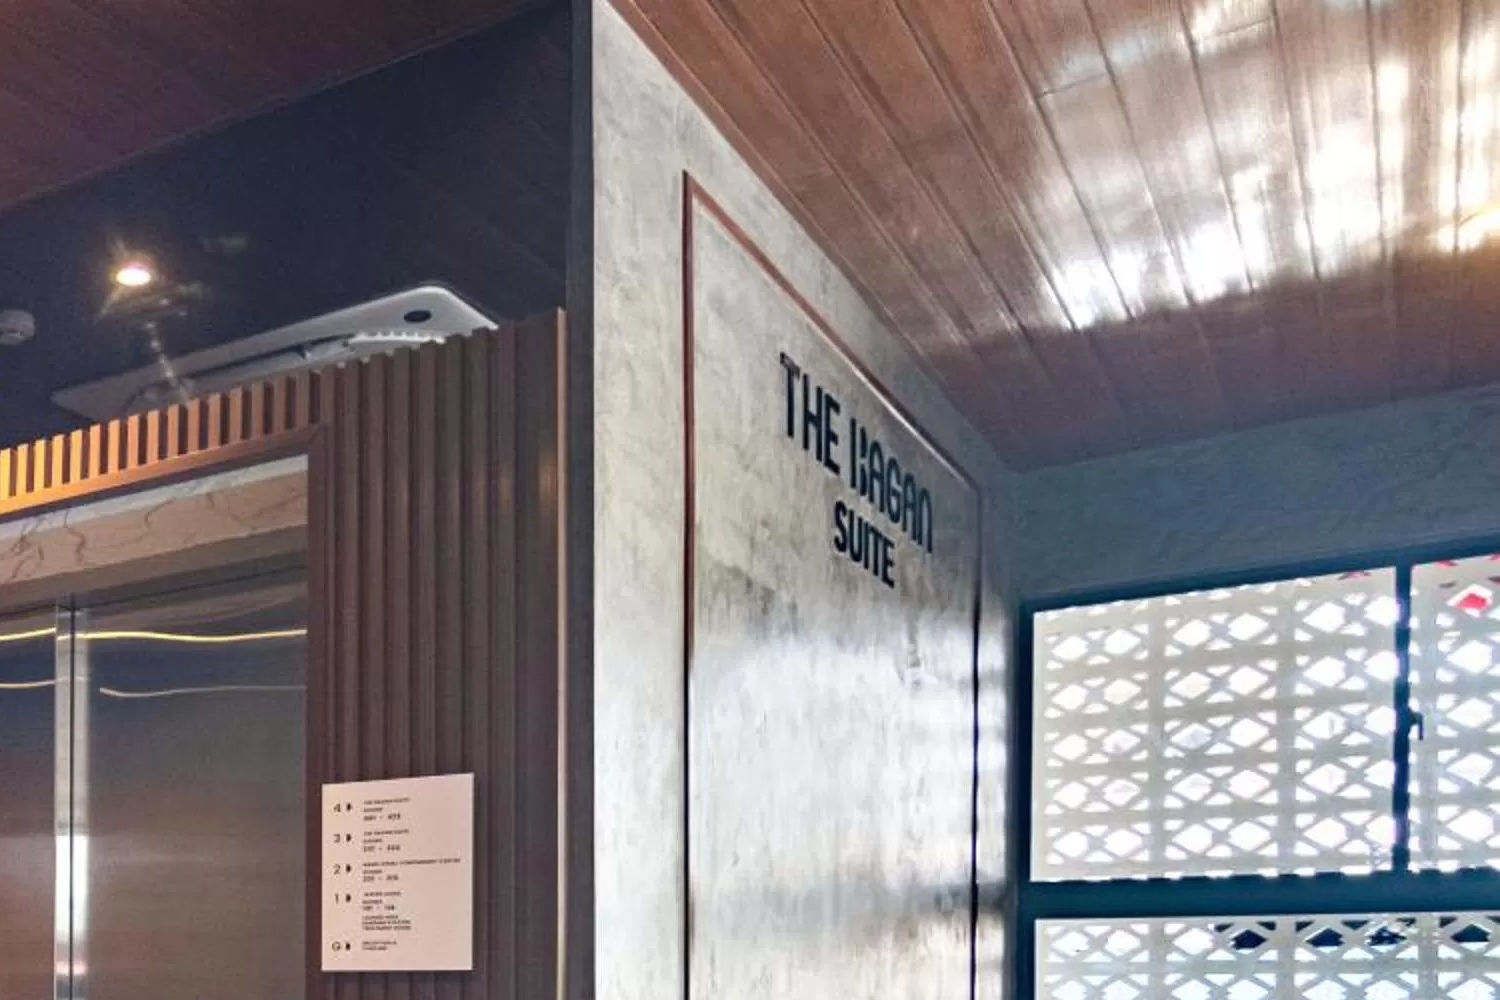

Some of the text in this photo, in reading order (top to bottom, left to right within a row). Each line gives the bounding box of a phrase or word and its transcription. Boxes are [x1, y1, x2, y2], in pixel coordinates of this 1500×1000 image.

[780, 352, 840, 475] THE
[834, 501, 895, 589] SUITE
[333, 833, 341, 843] 3
[333, 864, 341, 875] 2
